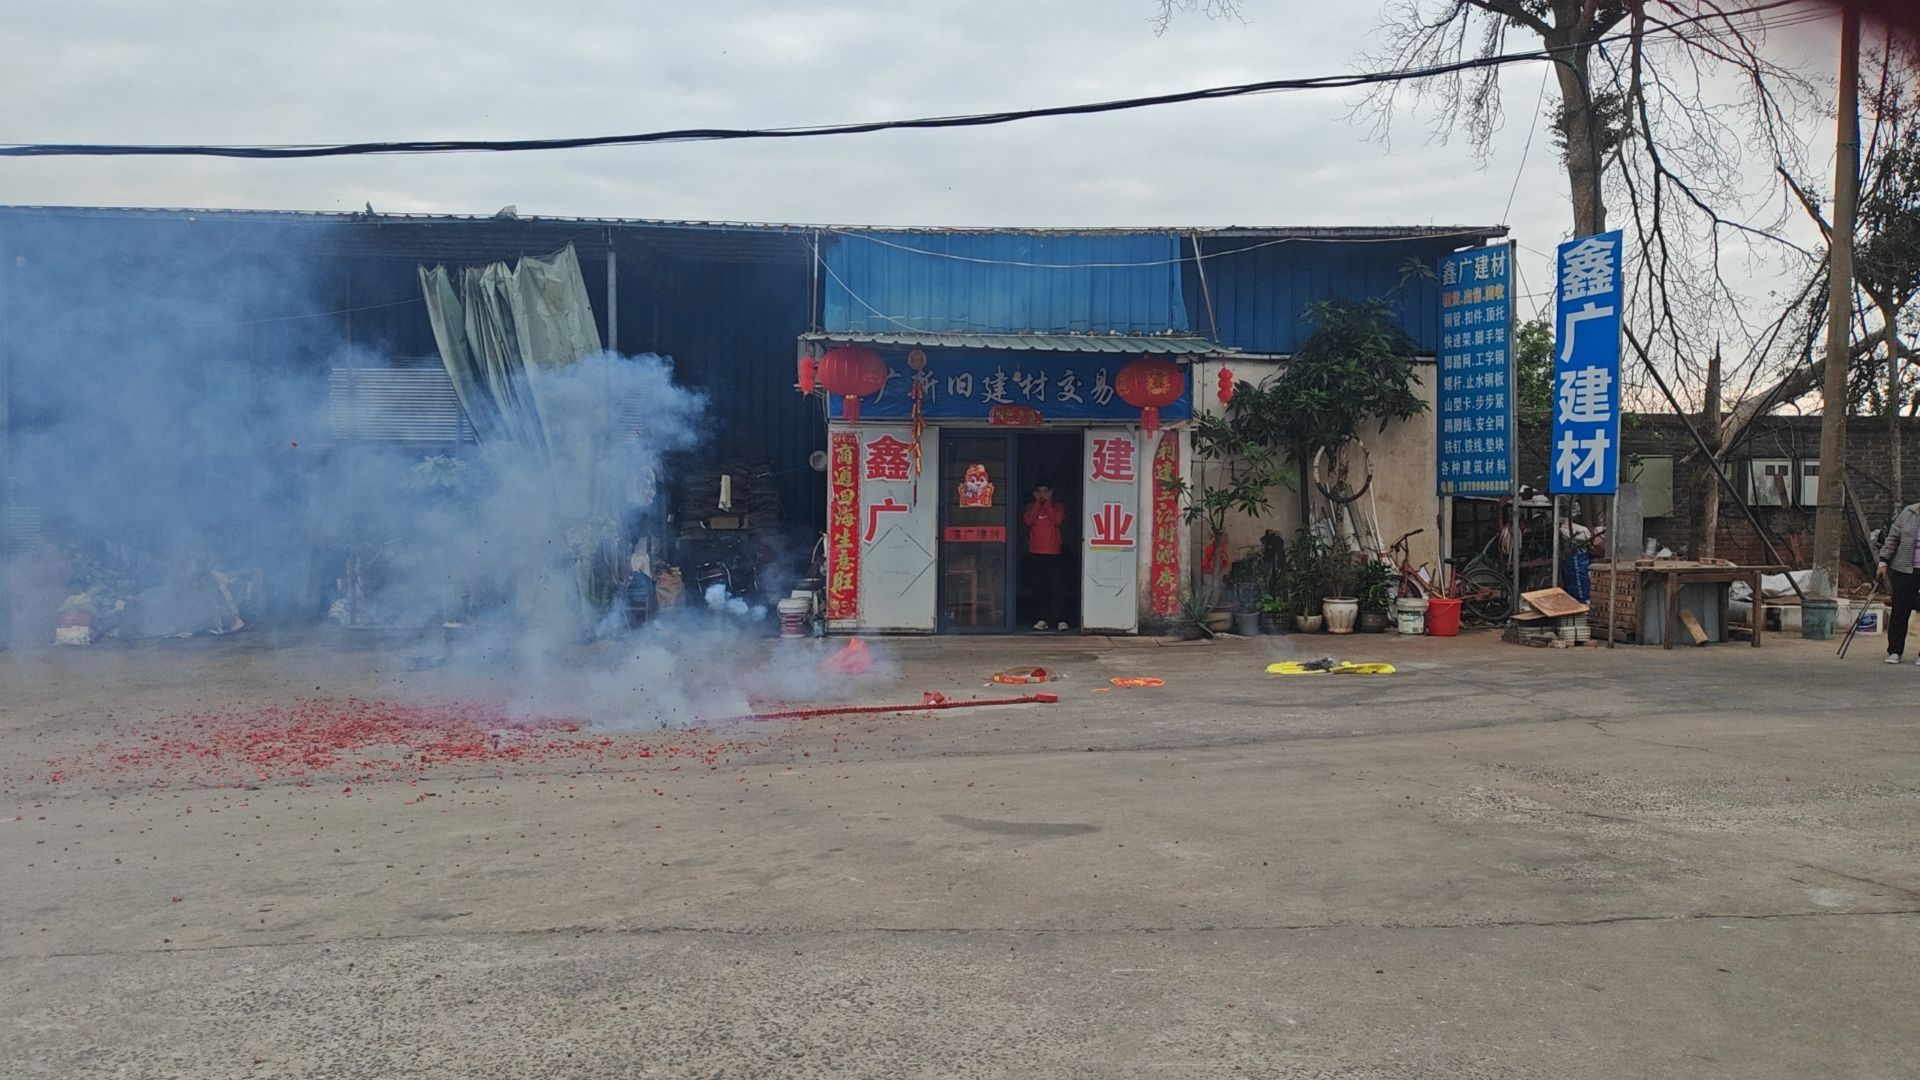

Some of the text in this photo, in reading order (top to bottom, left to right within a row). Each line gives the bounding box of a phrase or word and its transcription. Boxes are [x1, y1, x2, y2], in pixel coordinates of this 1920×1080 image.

[1442, 250, 1506, 286] 鑫广建材
[860, 366, 1114, 406] 广新旧建材交易
[1556, 238, 1616, 488] 鑫广建材
[864, 435, 912, 543] 鑫广
[1090, 437, 1135, 547] 建业
[1441, 458, 1506, 476] 各种建筑材料
